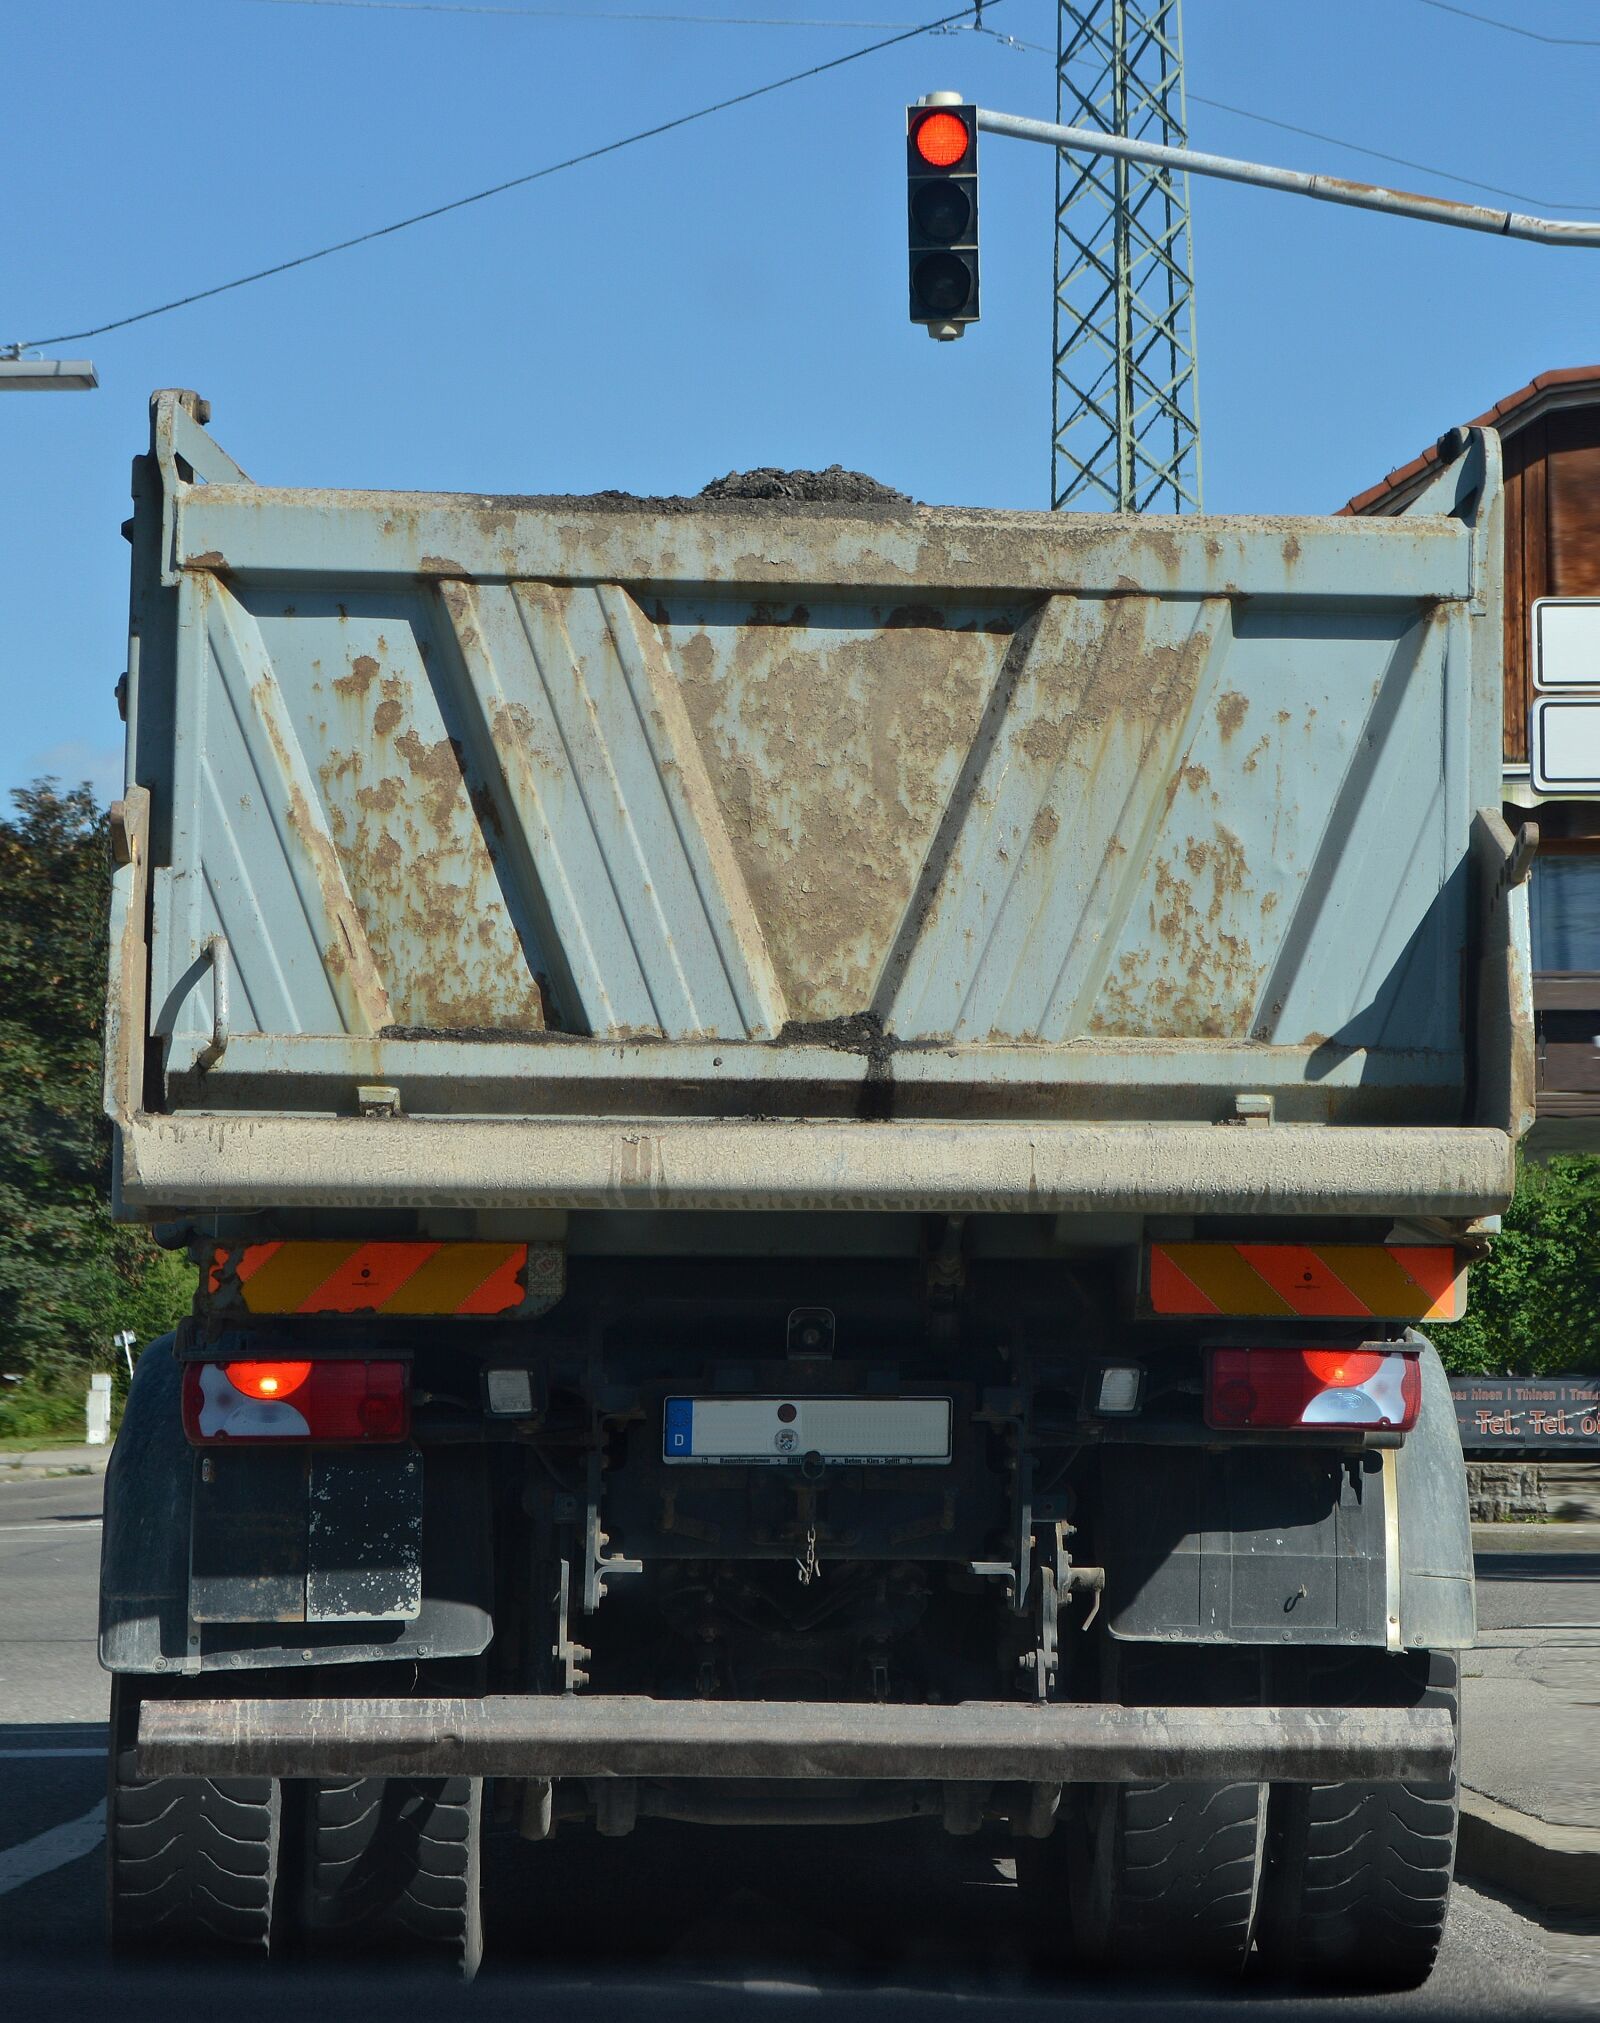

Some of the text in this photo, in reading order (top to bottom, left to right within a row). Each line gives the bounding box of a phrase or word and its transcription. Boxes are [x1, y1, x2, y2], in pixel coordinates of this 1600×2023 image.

[1475, 1410, 1521, 1435] Tel.
[1529, 1410, 1575, 1435] Tel.
[674, 1434, 684, 1446] D
